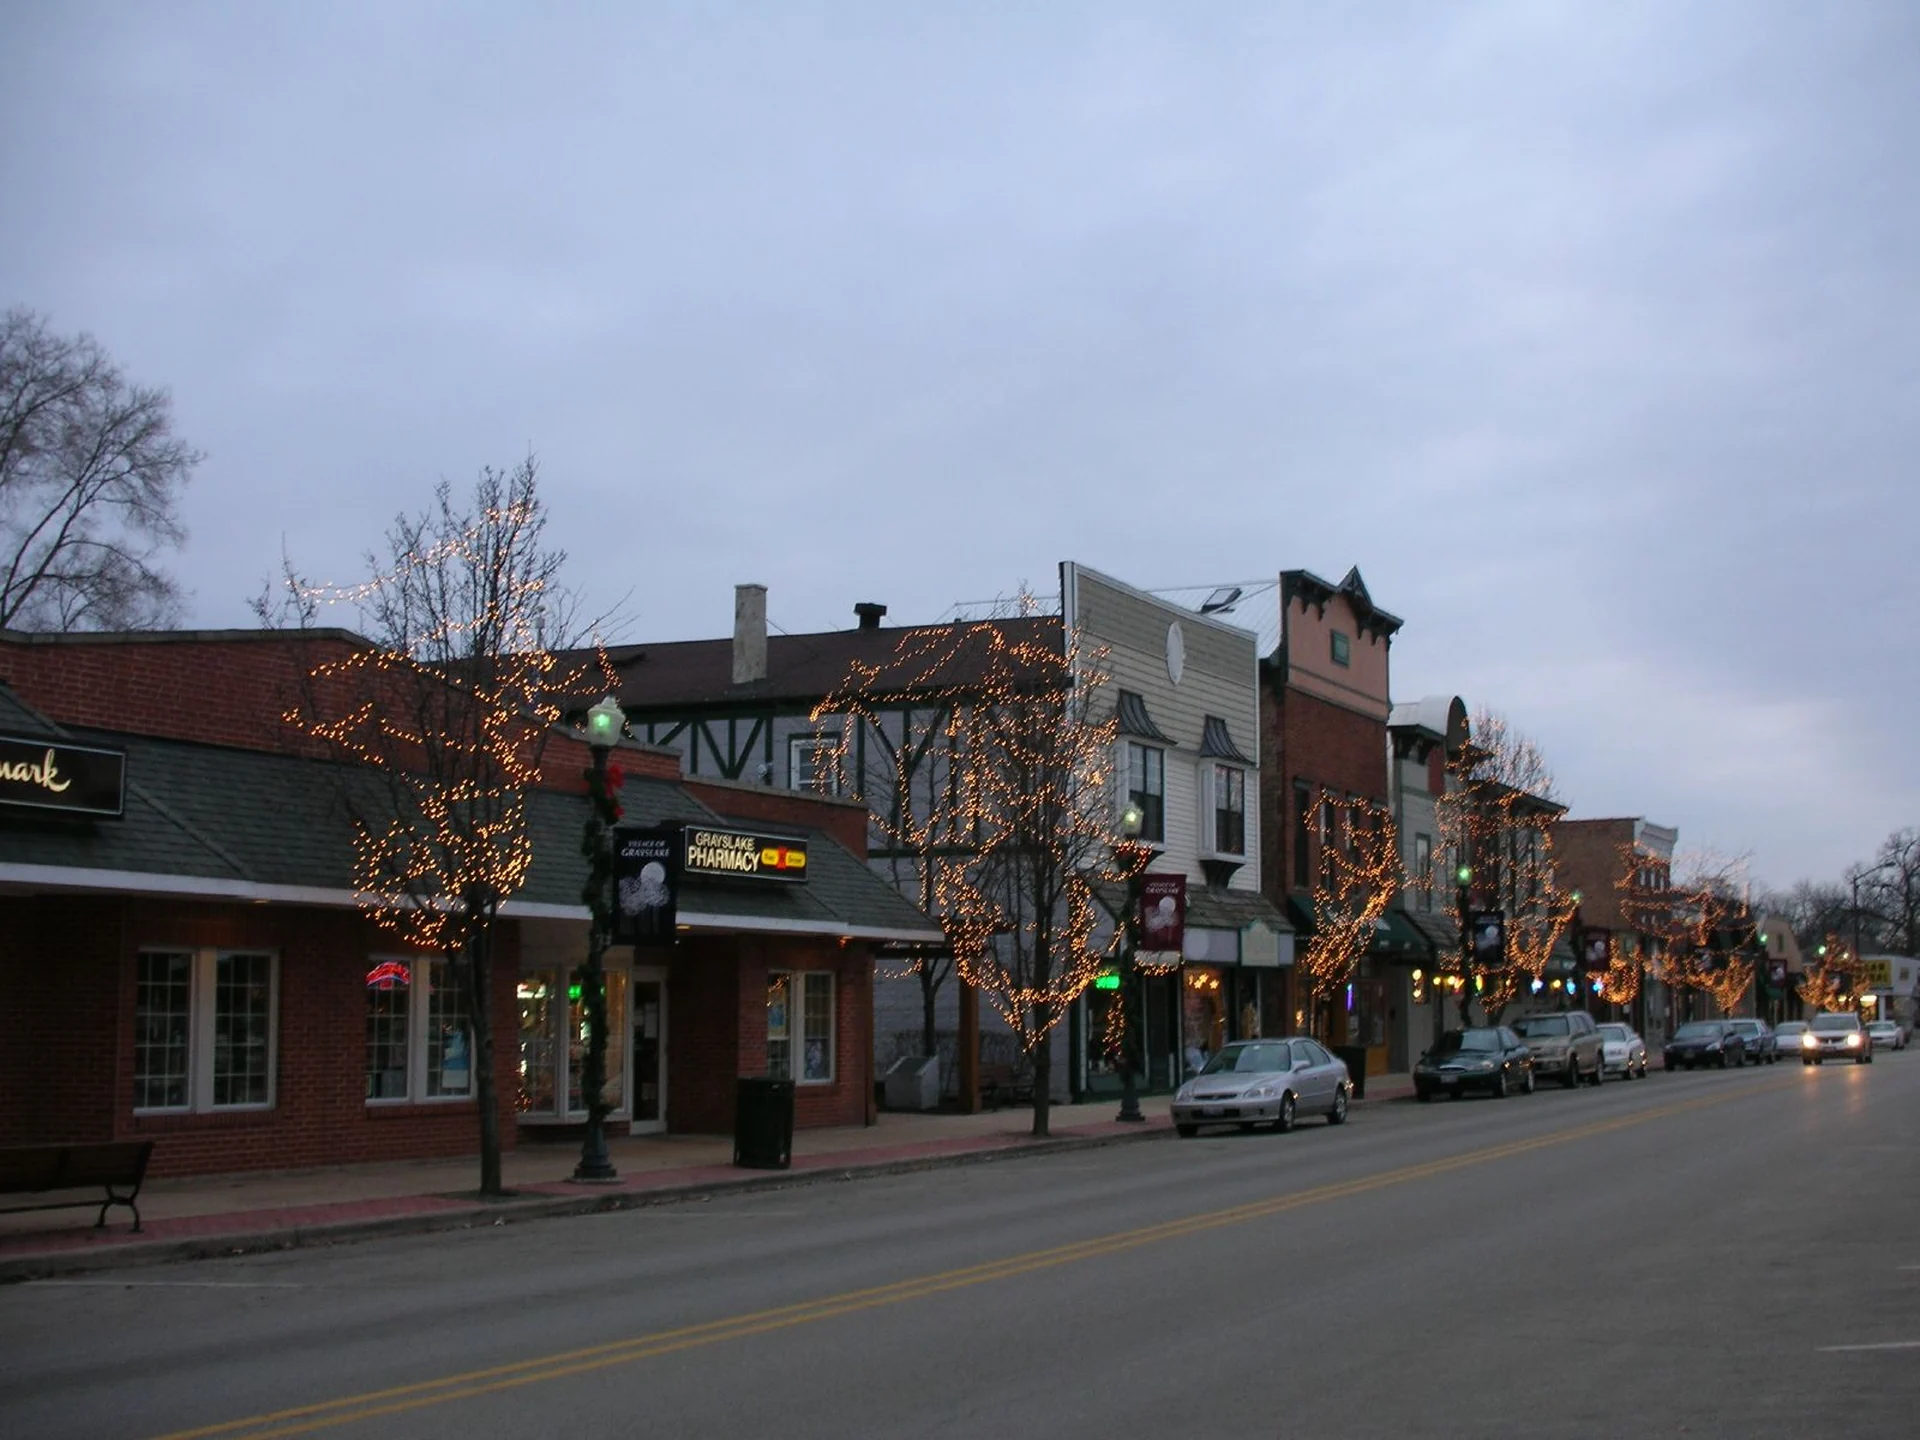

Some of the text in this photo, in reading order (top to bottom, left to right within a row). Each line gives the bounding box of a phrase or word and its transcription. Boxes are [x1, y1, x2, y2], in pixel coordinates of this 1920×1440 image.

[695, 831, 756, 851] GRAYSLAKE
[620, 847, 671, 857] GRAYSLAKE
[688, 844, 761, 872] PHARMACY
